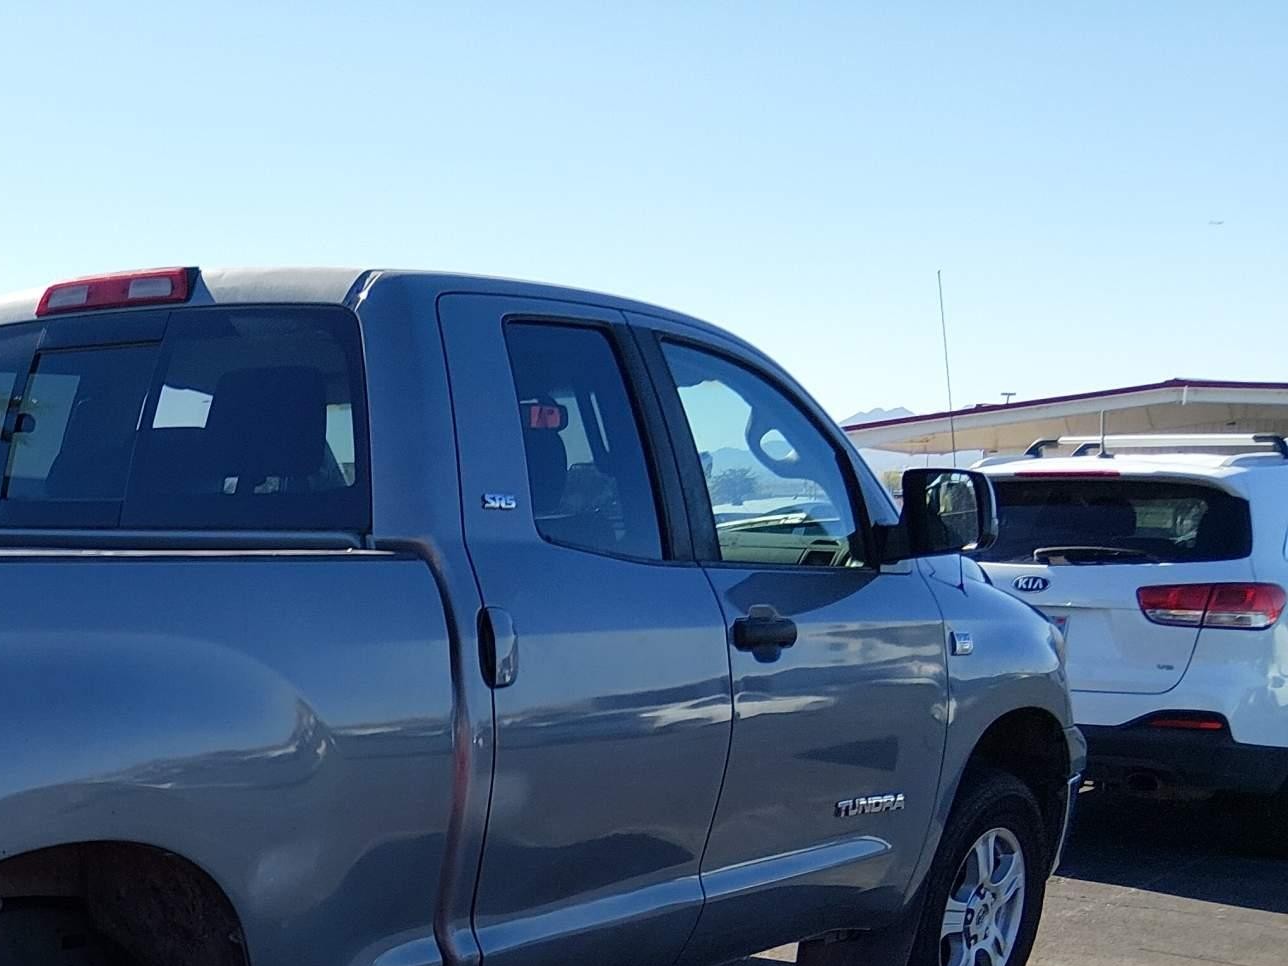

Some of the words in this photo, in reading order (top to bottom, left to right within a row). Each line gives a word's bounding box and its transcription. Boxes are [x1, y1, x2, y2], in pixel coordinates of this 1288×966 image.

[484, 494, 517, 509] SR5
[1018, 578, 1043, 589] KIA
[836, 793, 905, 817] TUNDRA
